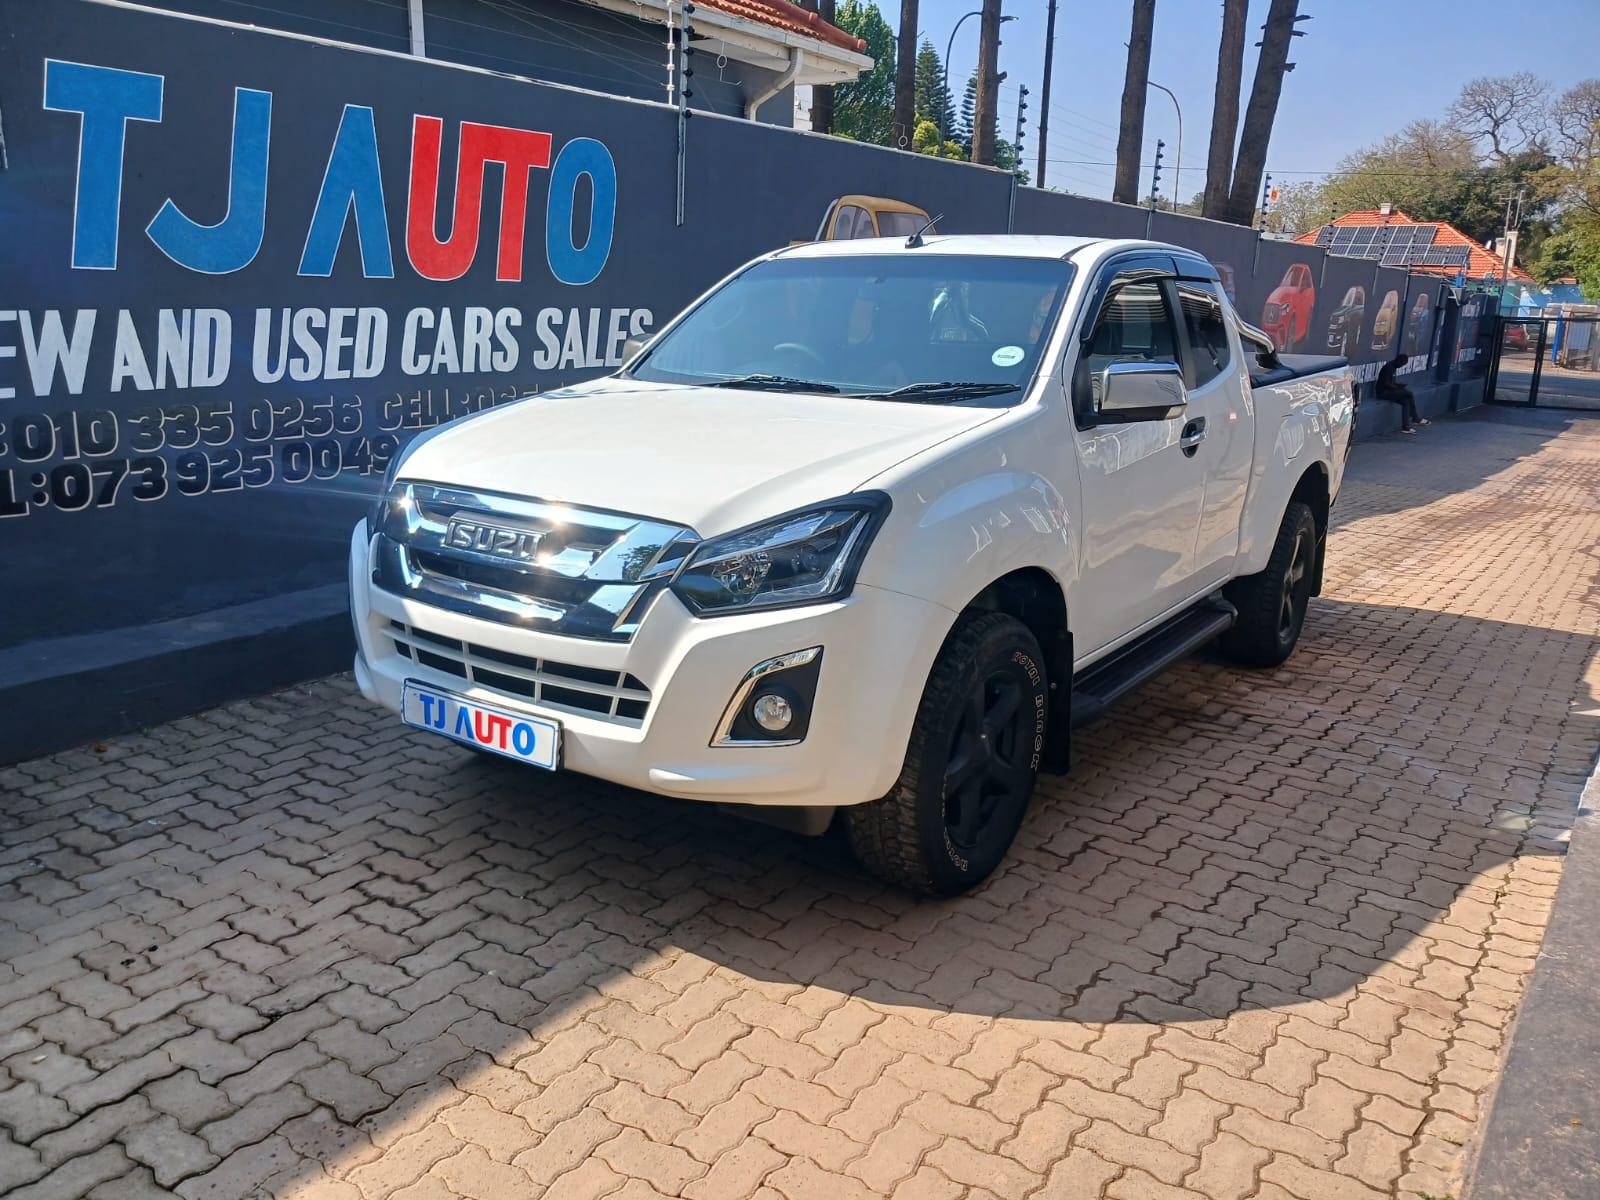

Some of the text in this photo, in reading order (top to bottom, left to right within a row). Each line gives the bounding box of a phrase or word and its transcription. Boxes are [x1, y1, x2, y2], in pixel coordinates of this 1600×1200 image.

[43, 58, 617, 286] TJ AUTO
[110, 309, 232, 392] AND
[252, 307, 389, 384] USED
[400, 307, 522, 376] CARS
[127, 400, 235, 452] 335
[242, 394, 362, 442] 0256
[176, 445, 274, 496] 925
[281, 434, 400, 483] 0049
[445, 521, 544, 561] ISUZU
[419, 694, 536, 756] TJ AUTO
